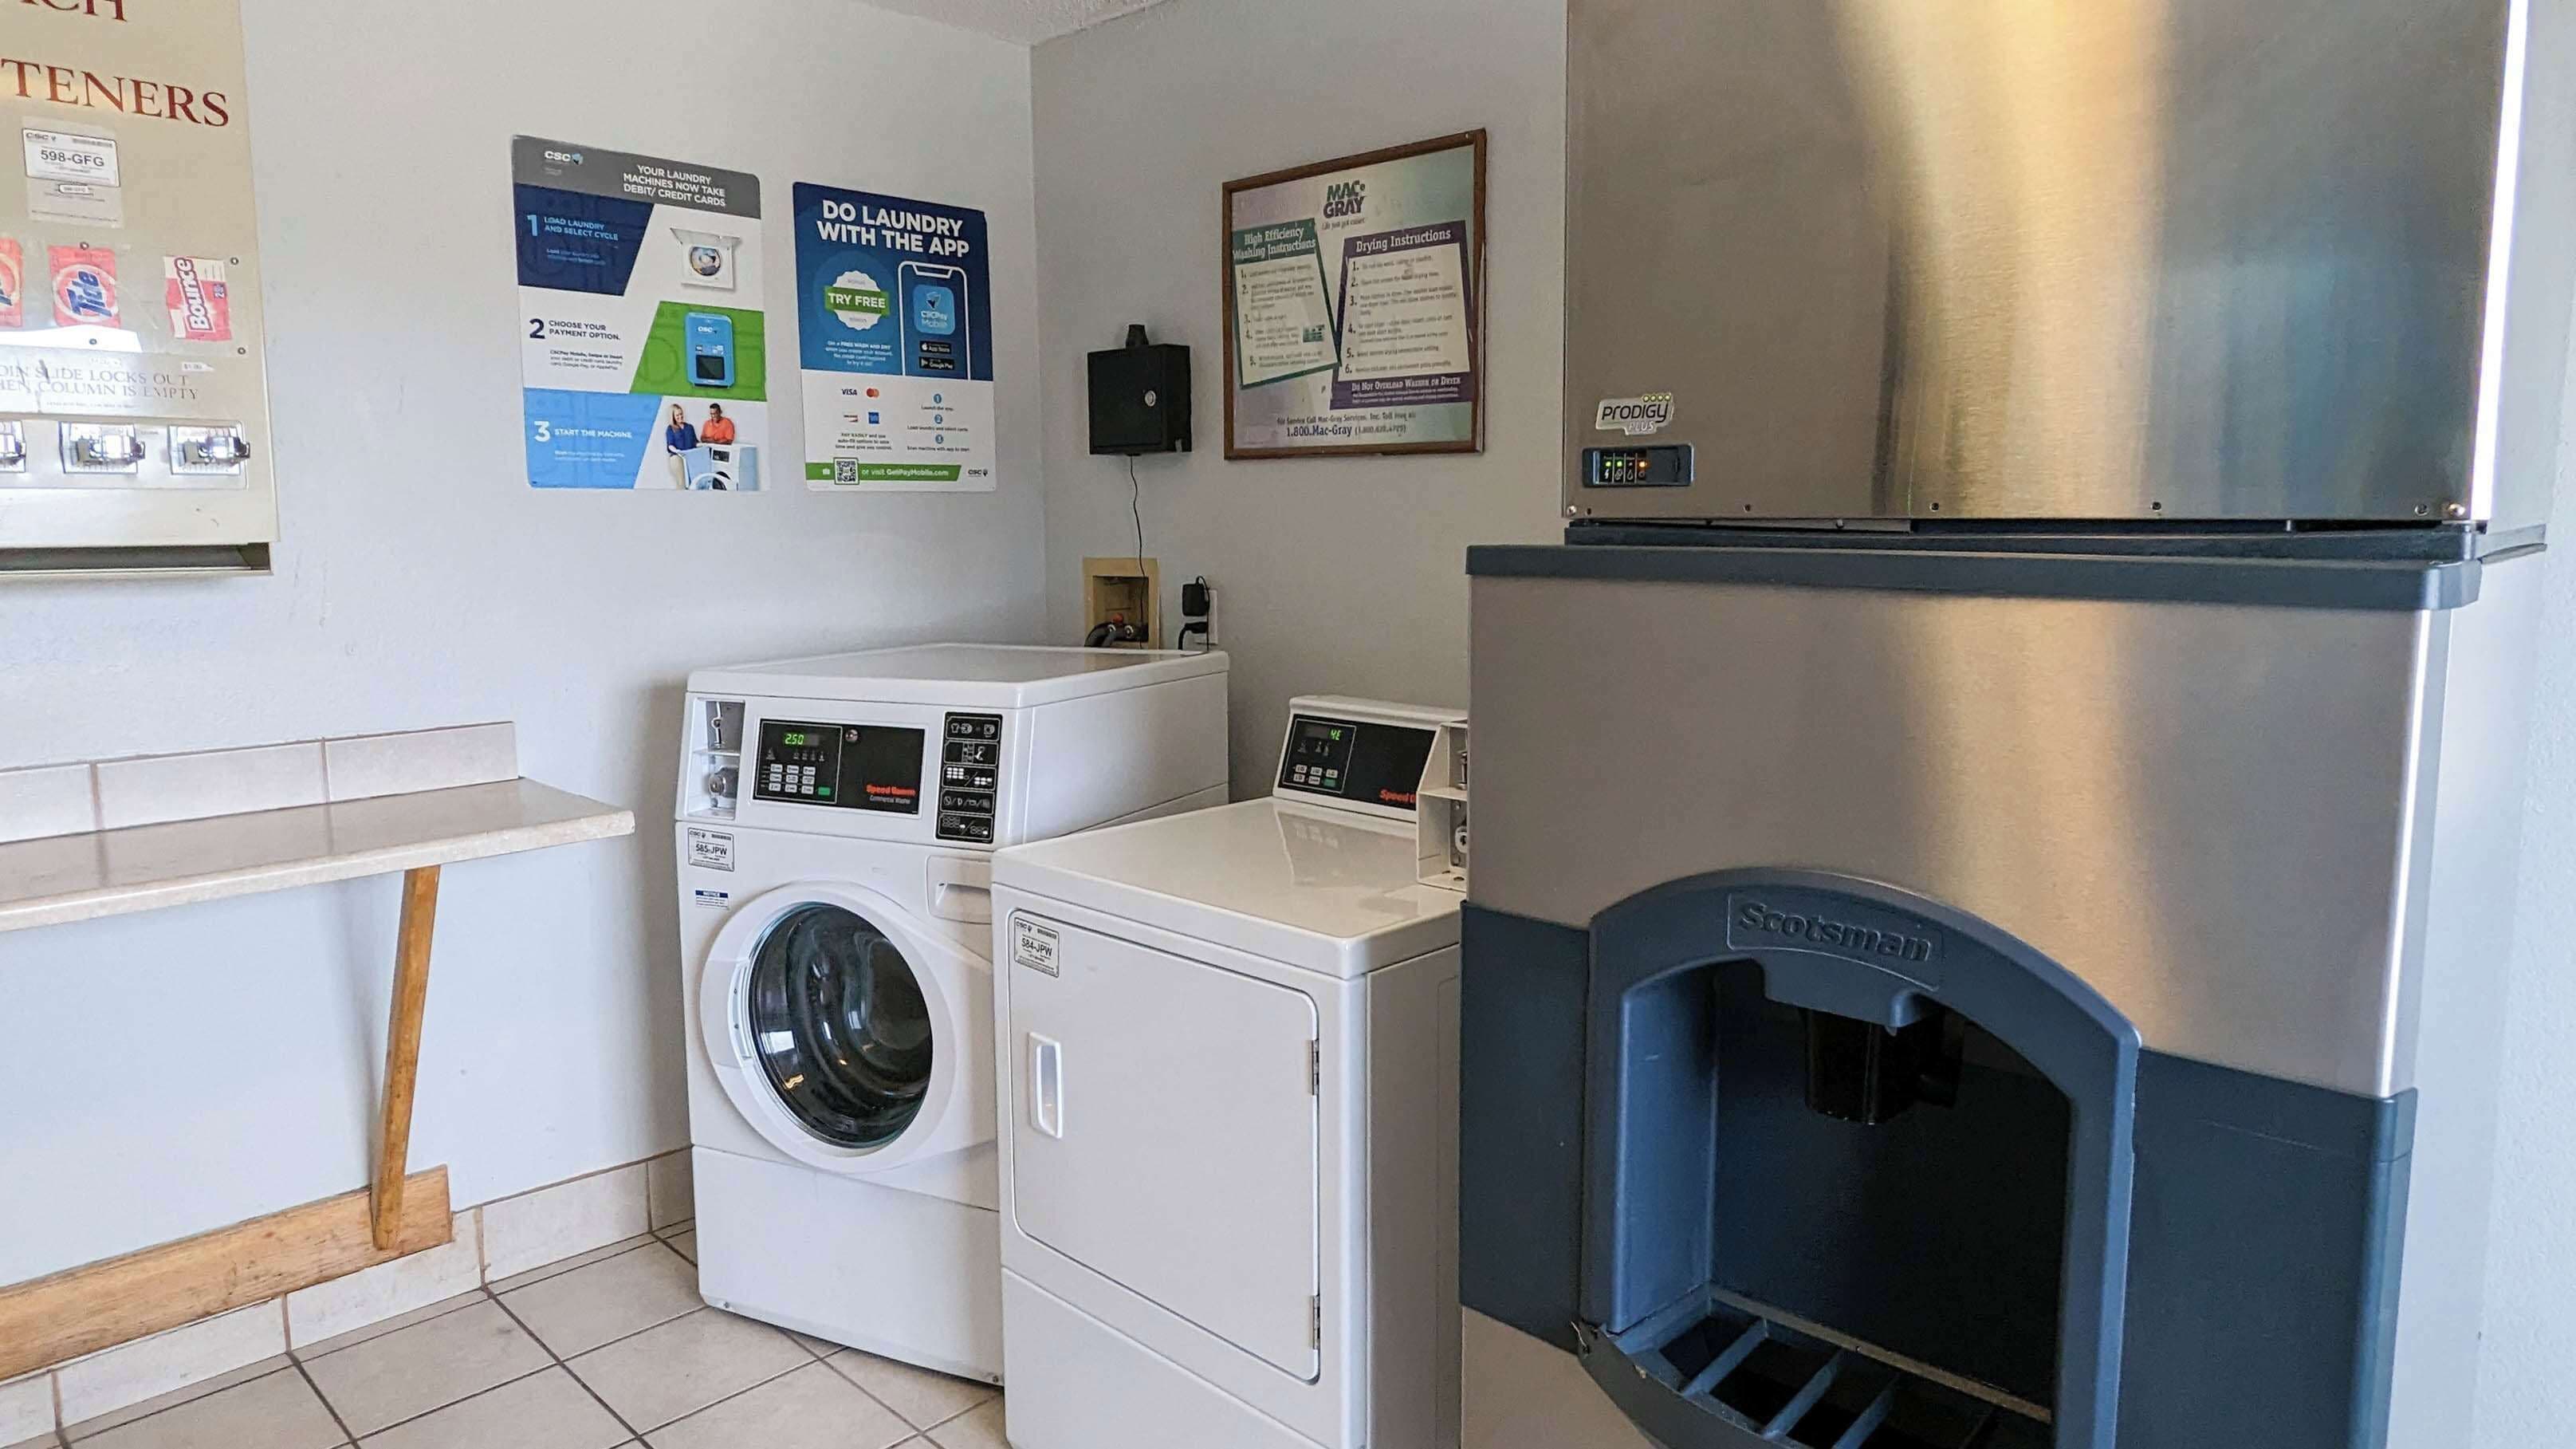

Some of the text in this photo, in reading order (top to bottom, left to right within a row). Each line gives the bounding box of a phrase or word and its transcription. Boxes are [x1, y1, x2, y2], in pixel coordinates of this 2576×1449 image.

[2, 58, 229, 127] TENERS
[41, 149, 104, 167] 598-GFG
[545, 150, 571, 162] CSC
[637, 164, 711, 185] YOUR LAUNDRY
[623, 173, 726, 198] MACHINES NOW TAKE
[623, 183, 726, 207] DEBIT/ CREDIT CARDS
[1323, 195, 1367, 219] GRAY
[527, 215, 537, 236] 1
[545, 217, 604, 231] LOAD LAUNDRY
[822, 199, 963, 237] DO LAUNDRY
[545, 225, 619, 241] AND SELECT CYCLE
[816, 220, 969, 258] WITH THE APP
[1245, 227, 1304, 247] High Efficiency
[1356, 229, 1451, 254] Drying Instructions
[1233, 238, 1316, 259] Washing Instructions
[66, 271, 112, 317] Tide
[175, 258, 214, 332] Bounce
[828, 293, 886, 309] TRY FREE
[529, 319, 545, 339] 2
[549, 320, 607, 332] CHOOSE YOUR
[549, 329, 620, 341] PAYMENT OPTION.
[35, 365, 81, 380] SLIDE
[89, 369, 147, 384] LOCKS
[153, 372, 189, 386] OUT
[1361, 381, 1374, 391] NOT
[1375, 380, 1403, 390] OVERLOAD
[38, 381, 116, 396] COLUMN
[124, 385, 136, 396] IS
[144, 386, 199, 400] EMPTY
[534, 420, 550, 443] 3
[554, 428, 579, 437] START
[597, 430, 632, 439] MACHINE
[1628, 420, 1654, 431] PLUS
[695, 843, 727, 856] 585-JPW
[1739, 901, 1932, 962] Scotsman
[1021, 937, 1052, 957] 584-JPW
